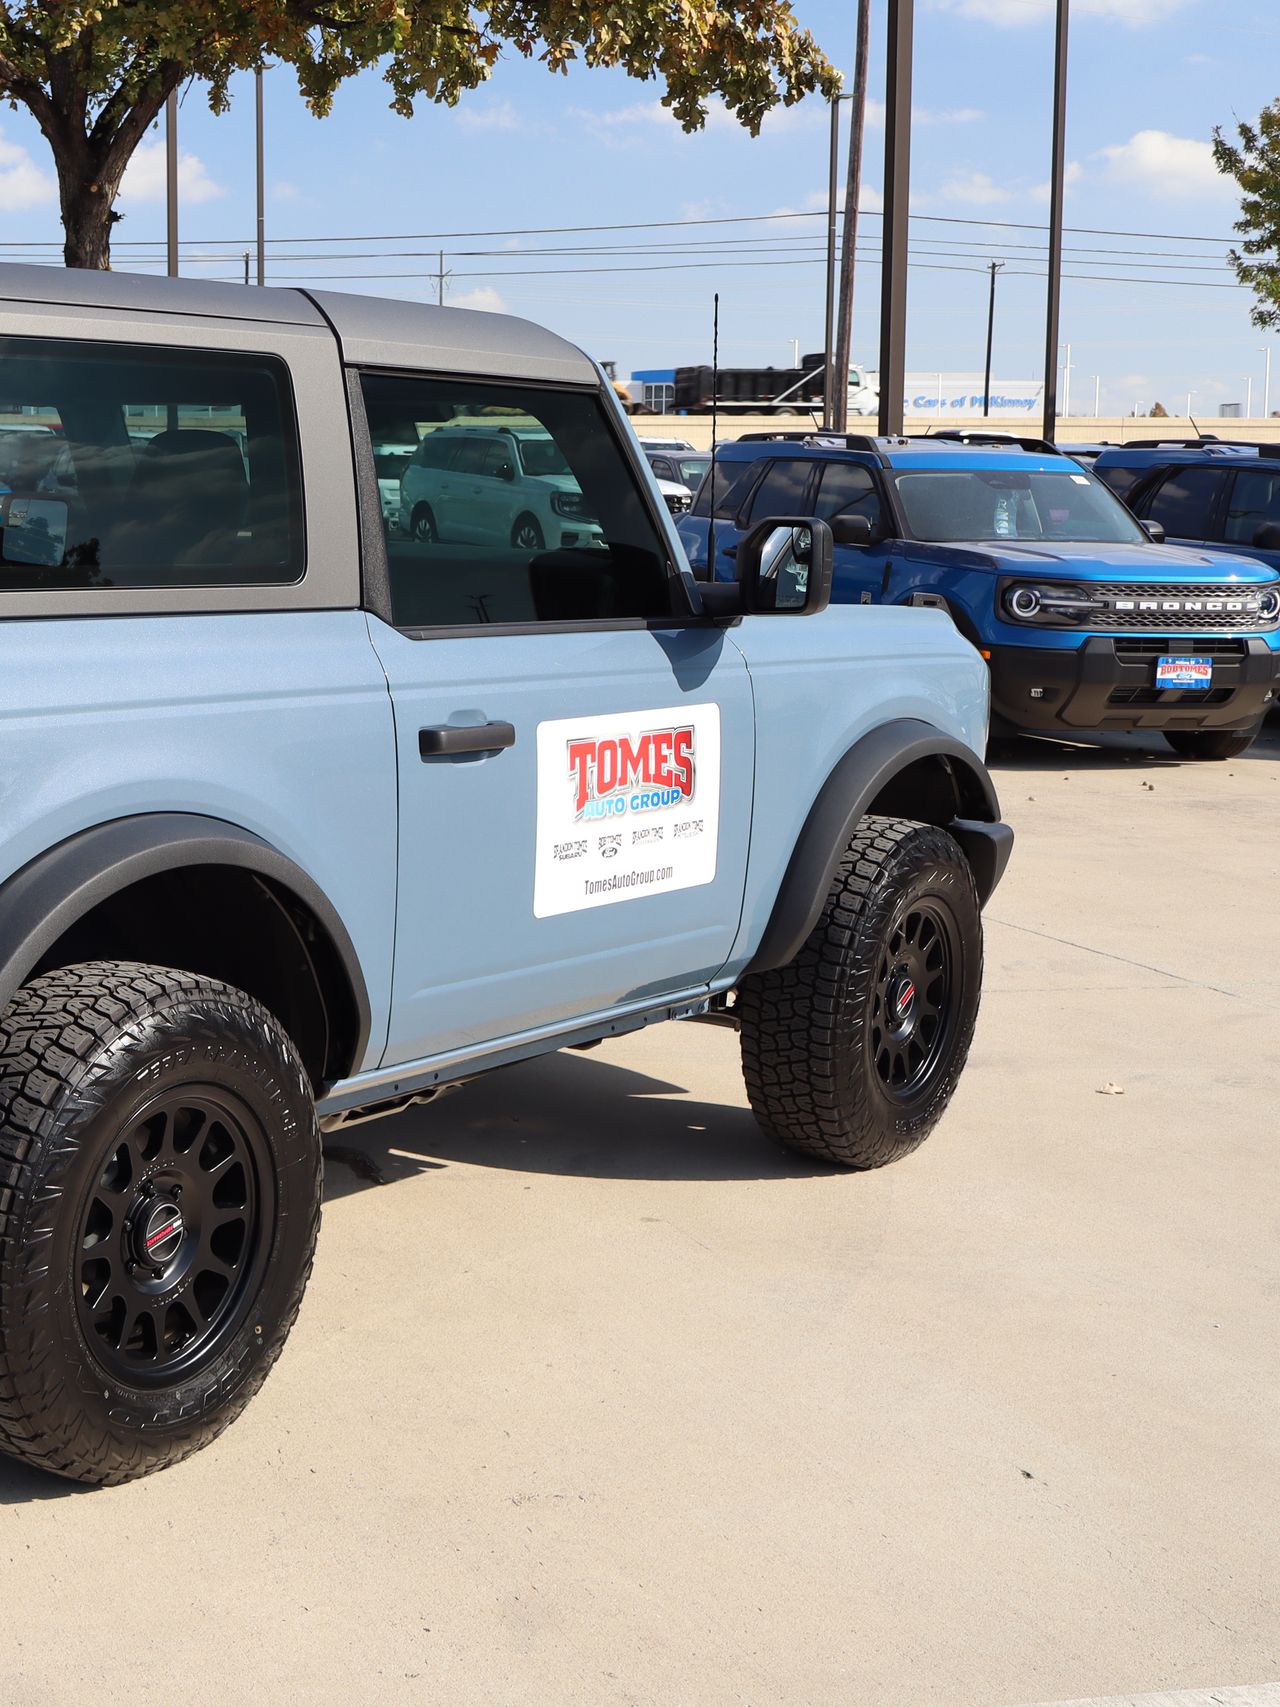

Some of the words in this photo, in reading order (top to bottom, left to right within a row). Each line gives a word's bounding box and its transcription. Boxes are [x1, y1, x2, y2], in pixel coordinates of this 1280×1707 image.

[951, 394, 967, 408] of
[971, 394, 1037, 411] MKinney
[1115, 601, 1242, 611] BRONCO
[568, 728, 693, 814] TOMES
[584, 797, 626, 817] AUTO
[630, 788, 682, 811] GROUP
[584, 866, 674, 895] TomesAutoGroup.com
